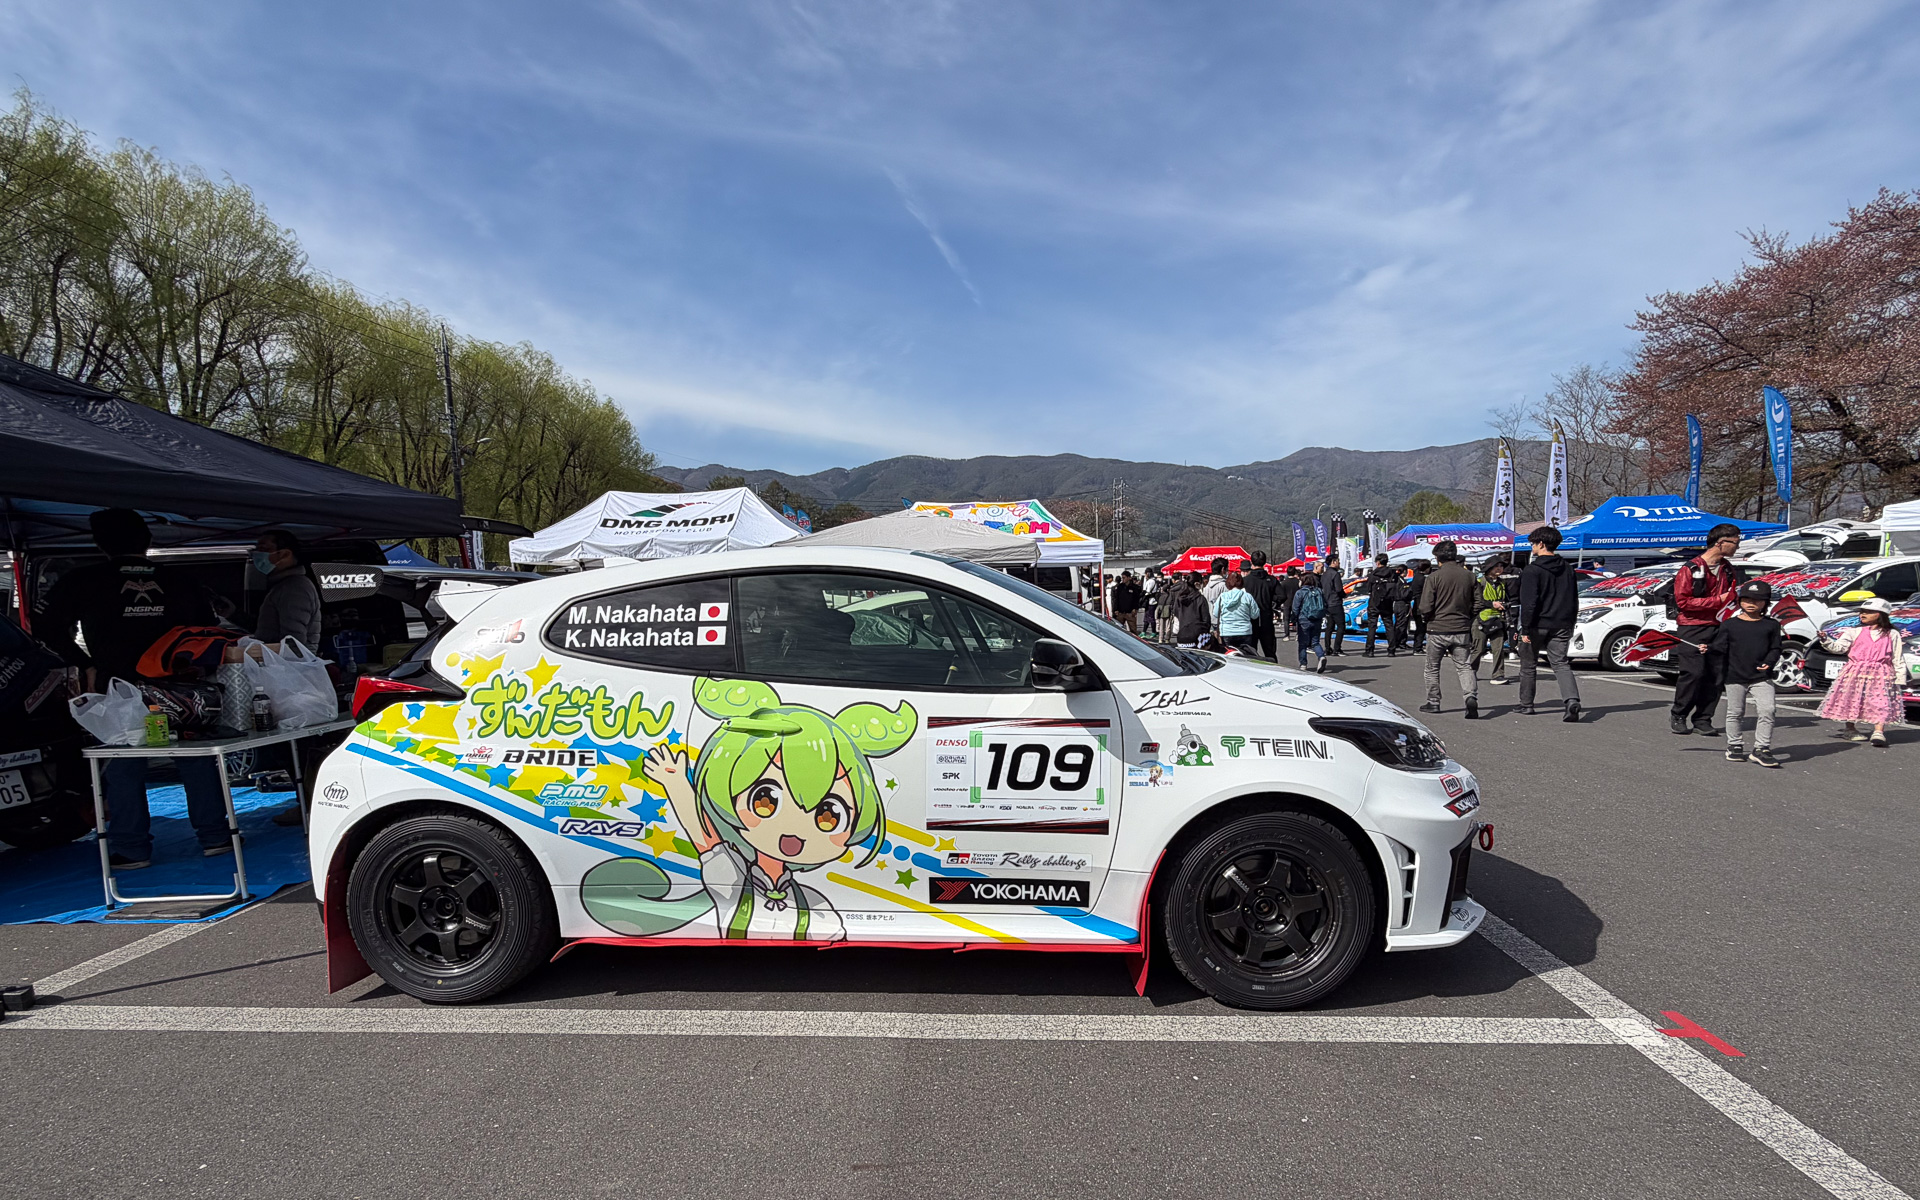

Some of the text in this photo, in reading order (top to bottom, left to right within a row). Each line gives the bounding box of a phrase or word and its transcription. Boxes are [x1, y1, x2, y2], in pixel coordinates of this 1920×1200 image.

[600, 513, 735, 529] DMG MORI
[1461, 534, 1508, 543] Garage
[320, 573, 375, 584] VOLTEX
[568, 604, 697, 624] M. Nakahata
[564, 626, 694, 648] K. Nakahata
[471, 674, 675, 740] ずんだもん
[1133, 689, 1211, 714] ZEAL
[935, 739, 968, 747] DENSO
[1249, 737, 1329, 760] TEIN
[502, 749, 596, 767] BRIDE
[942, 772, 960, 780] SPK
[986, 743, 1094, 792] 109
[543, 799, 578, 807] RACING
[560, 819, 645, 837] RAYS
[999, 852, 1087, 870] Rally challenge
[970, 883, 1081, 902] YOKOHAMA
